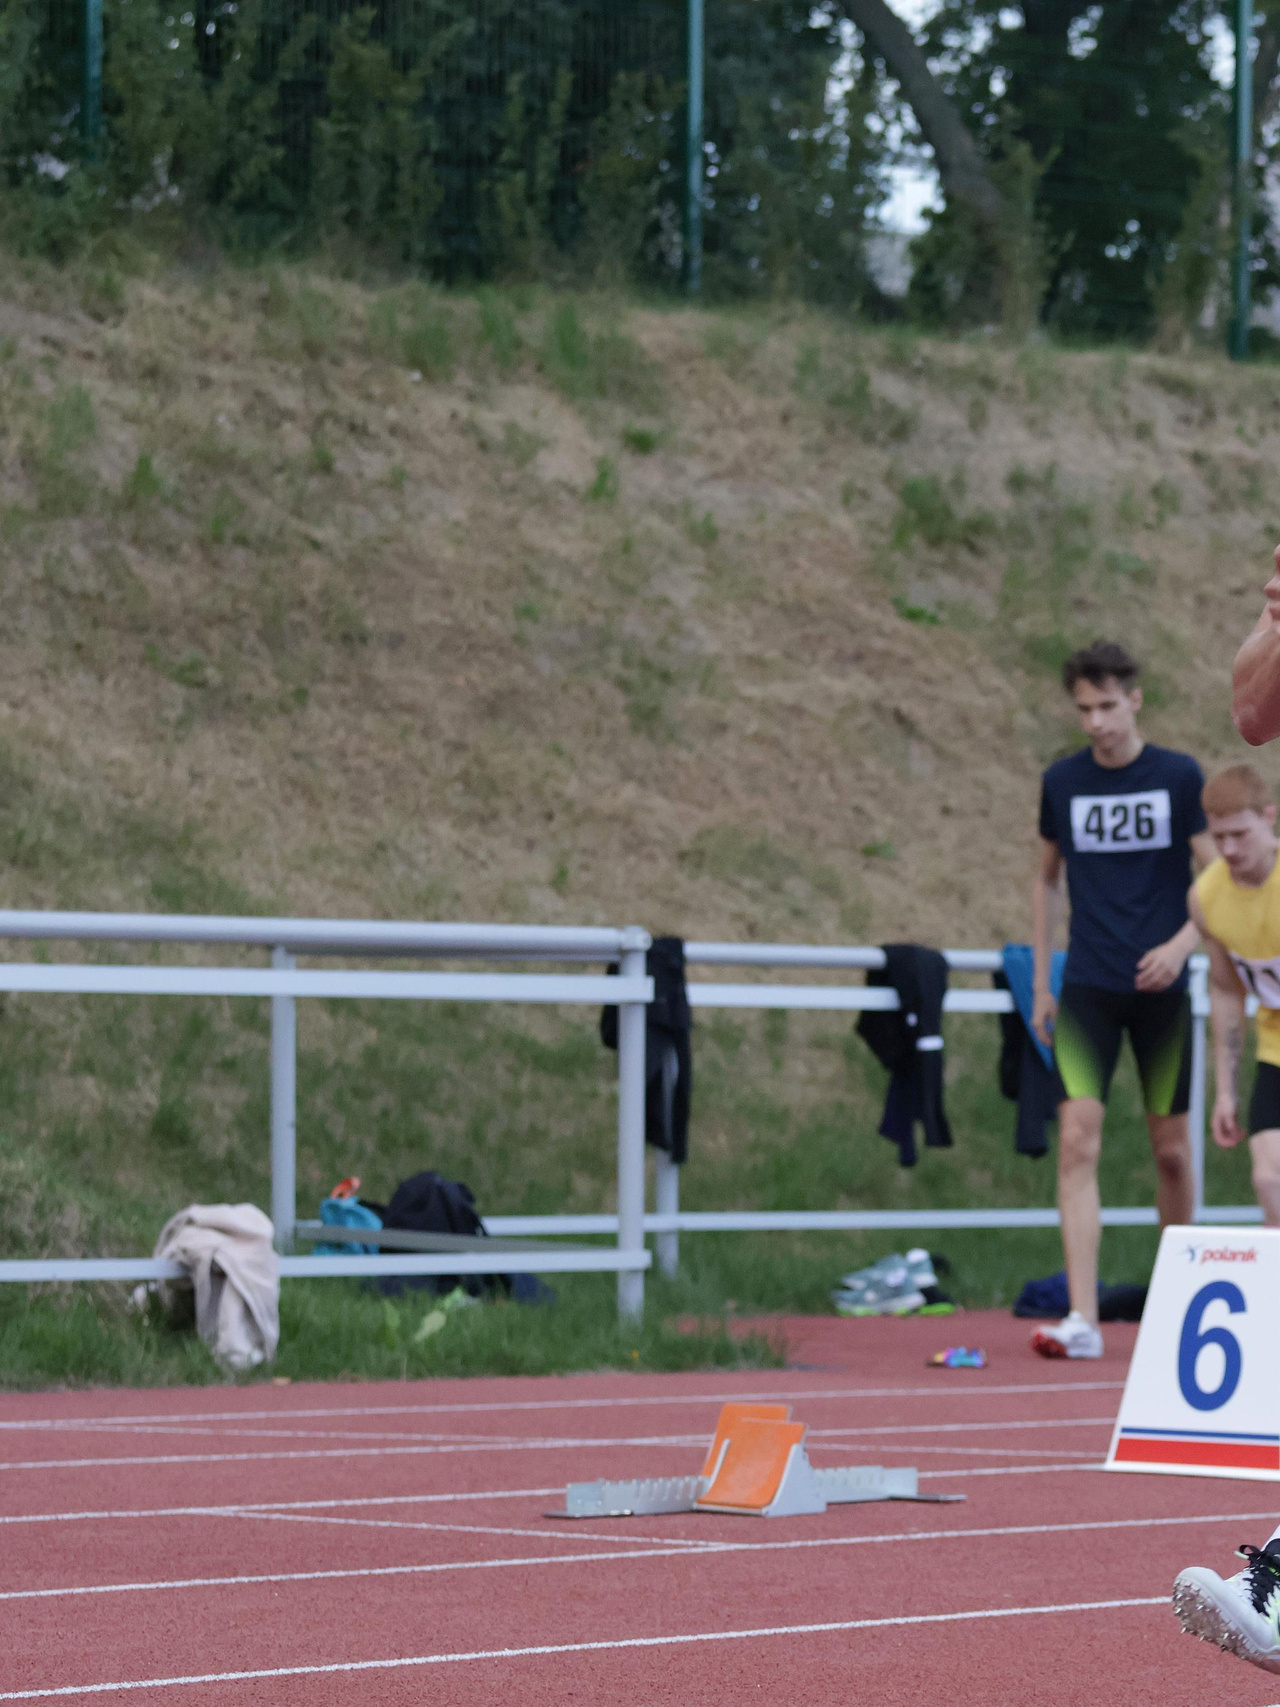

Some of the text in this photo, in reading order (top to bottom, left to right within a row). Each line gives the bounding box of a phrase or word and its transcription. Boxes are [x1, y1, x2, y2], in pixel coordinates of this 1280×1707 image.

[1085, 803, 1155, 842] 426
[1200, 1246, 1257, 1266] polanik
[1178, 1280, 1247, 1412] 6
